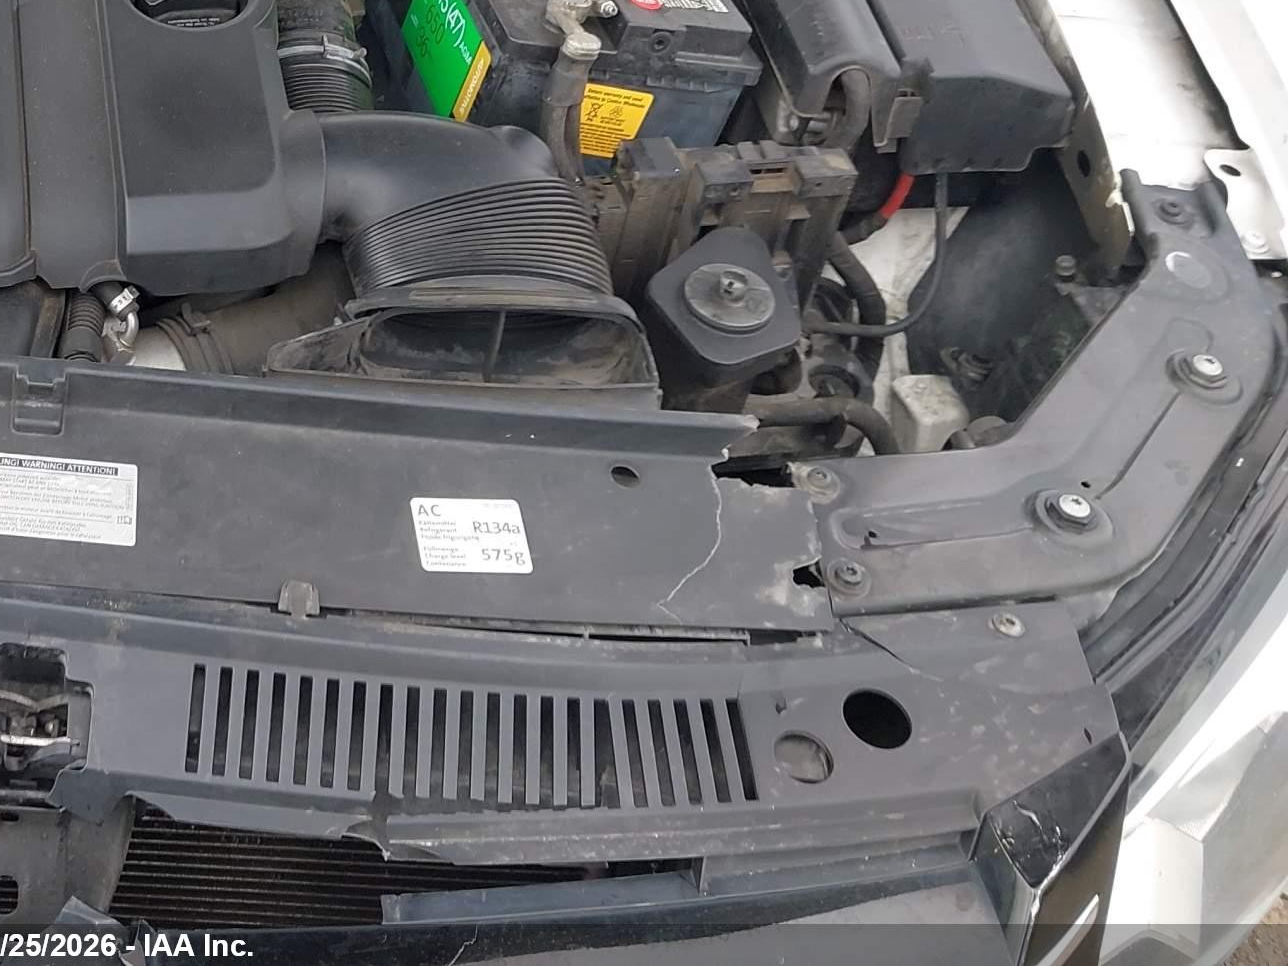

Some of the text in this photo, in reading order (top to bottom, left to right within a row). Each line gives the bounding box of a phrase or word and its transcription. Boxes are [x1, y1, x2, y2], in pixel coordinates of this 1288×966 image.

[425, 4, 445, 44] 650
[21, 459, 66, 471] WARNING!
[67, 464, 116, 475] ATTENTION!
[418, 504, 441, 517] AC
[472, 521, 521, 535] R134a
[481, 548, 526, 566] 575g
